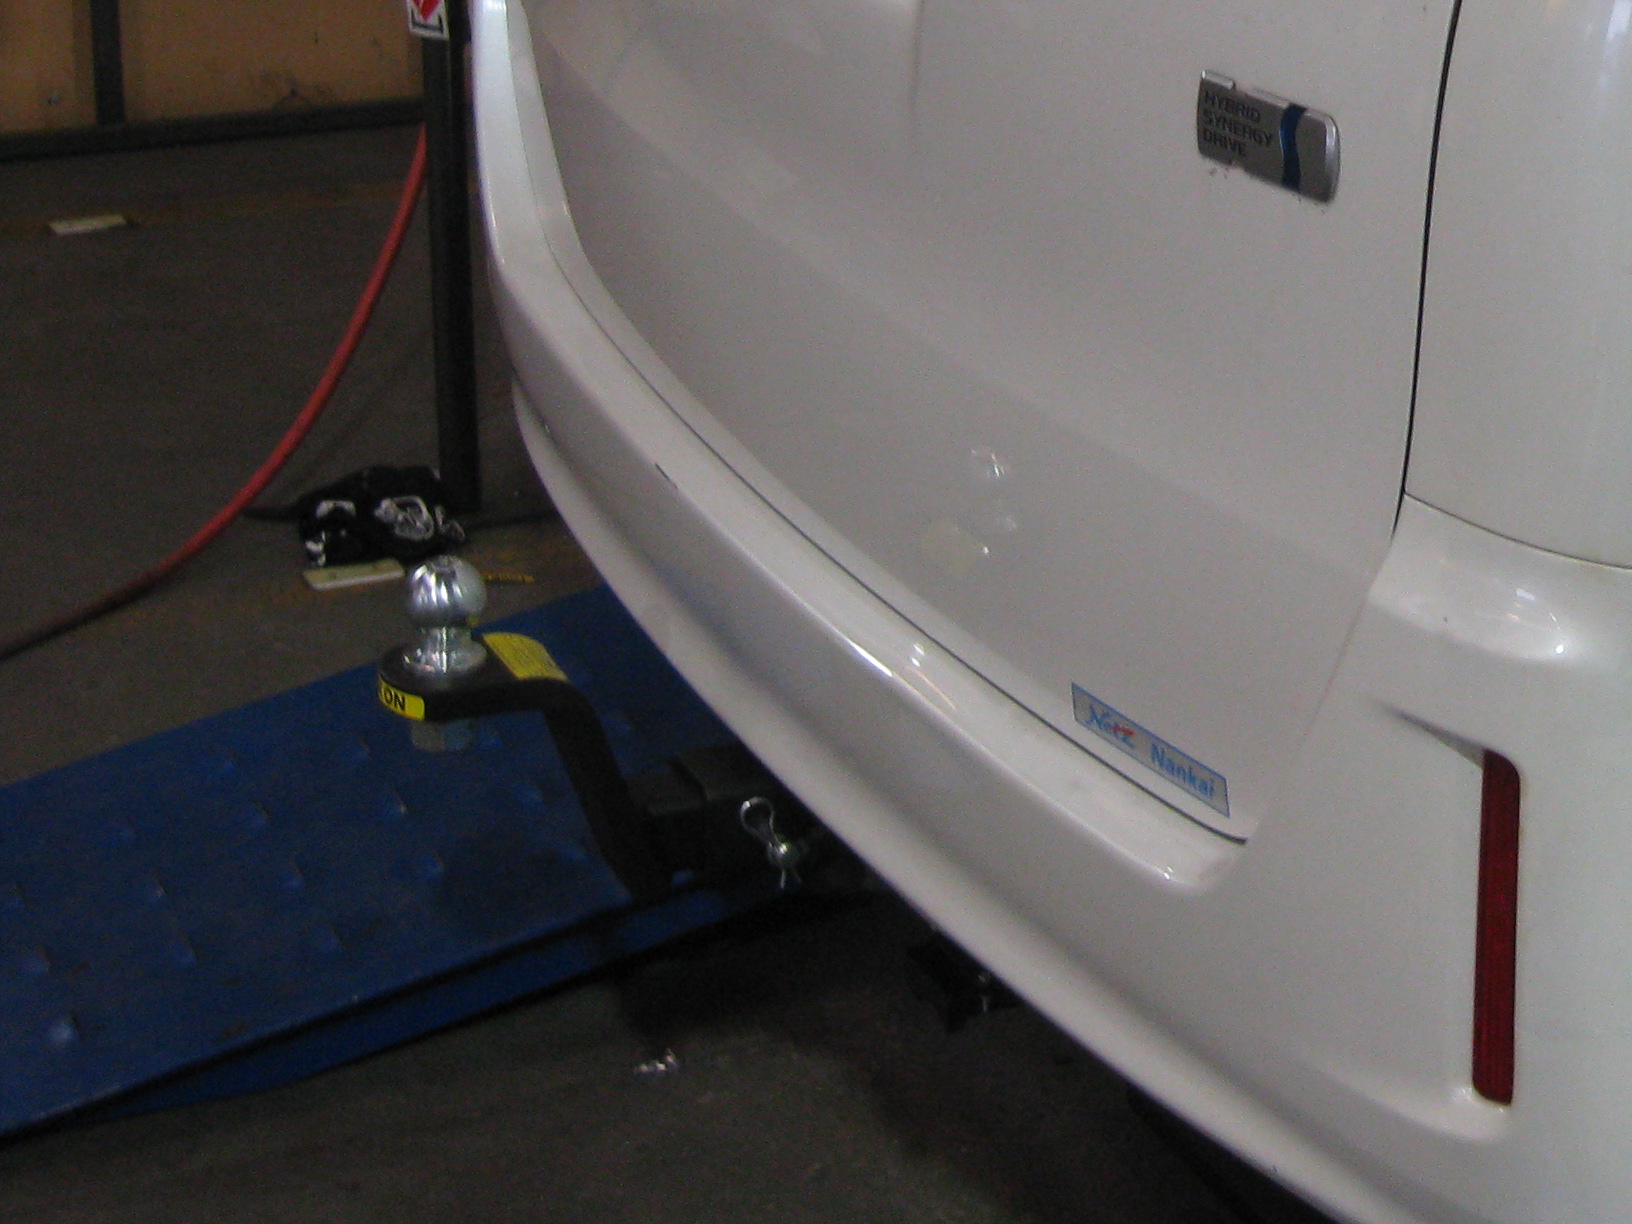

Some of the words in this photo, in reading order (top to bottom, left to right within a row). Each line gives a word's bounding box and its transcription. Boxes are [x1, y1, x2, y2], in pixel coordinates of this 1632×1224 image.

[1204, 90, 1261, 123] HYBRID
[1203, 109, 1273, 147] SYNERGY
[1203, 129, 1247, 156] DRIVE
[1151, 743, 1216, 799] Nankai
